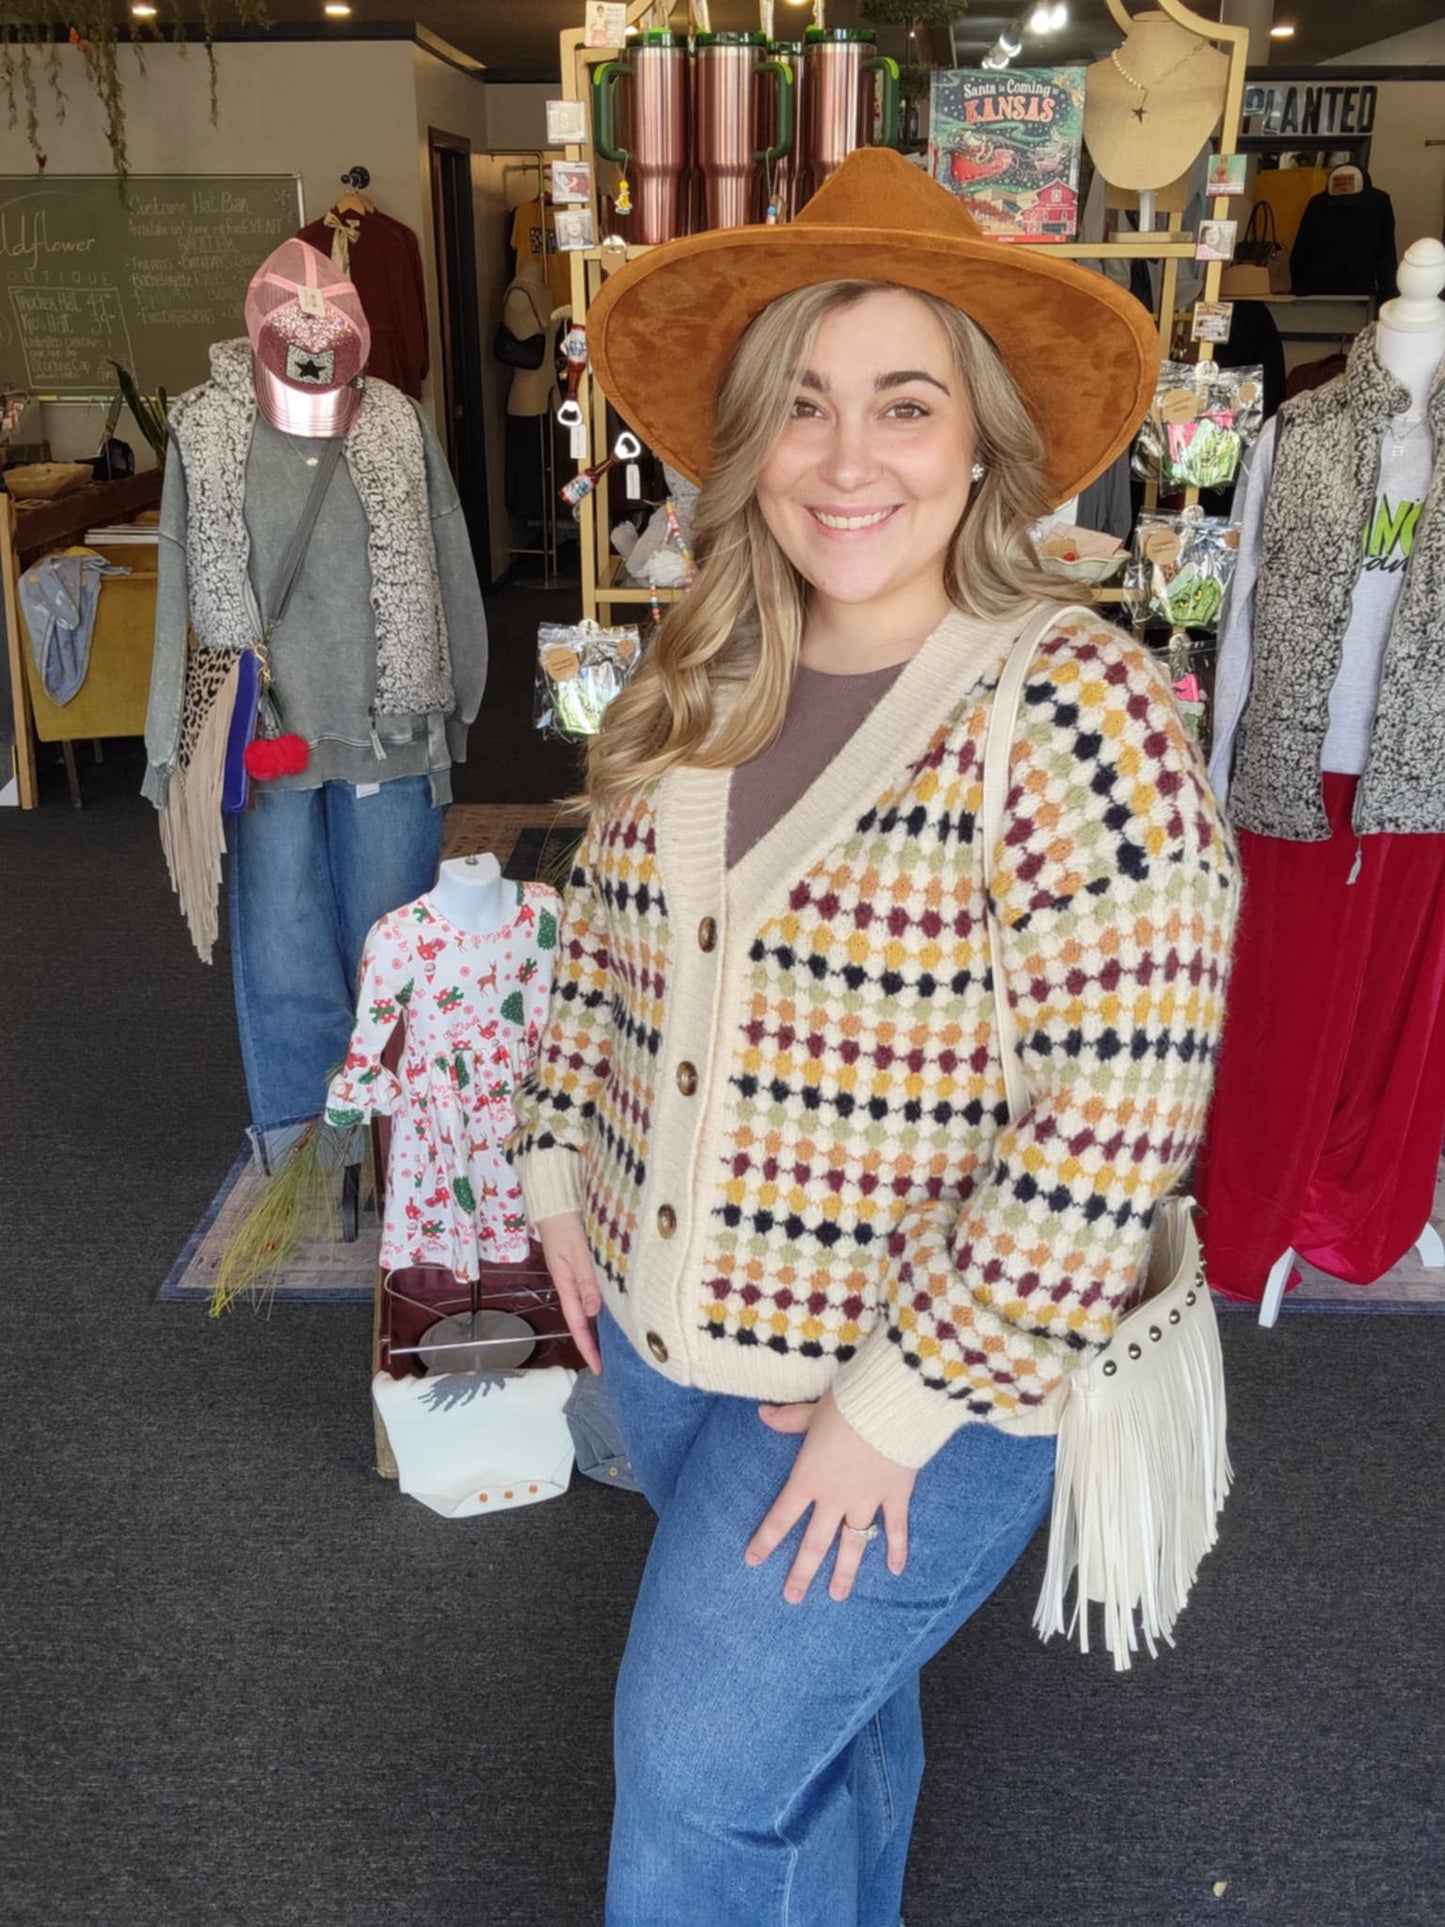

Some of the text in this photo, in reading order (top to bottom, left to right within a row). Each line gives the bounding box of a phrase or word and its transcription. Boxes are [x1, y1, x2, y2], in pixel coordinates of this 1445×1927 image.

[963, 83, 996, 98] Santa
[1007, 79, 1051, 98] Coming
[964, 95, 1056, 124] KANSAS
[1242, 85, 1377, 135] PLANTED
